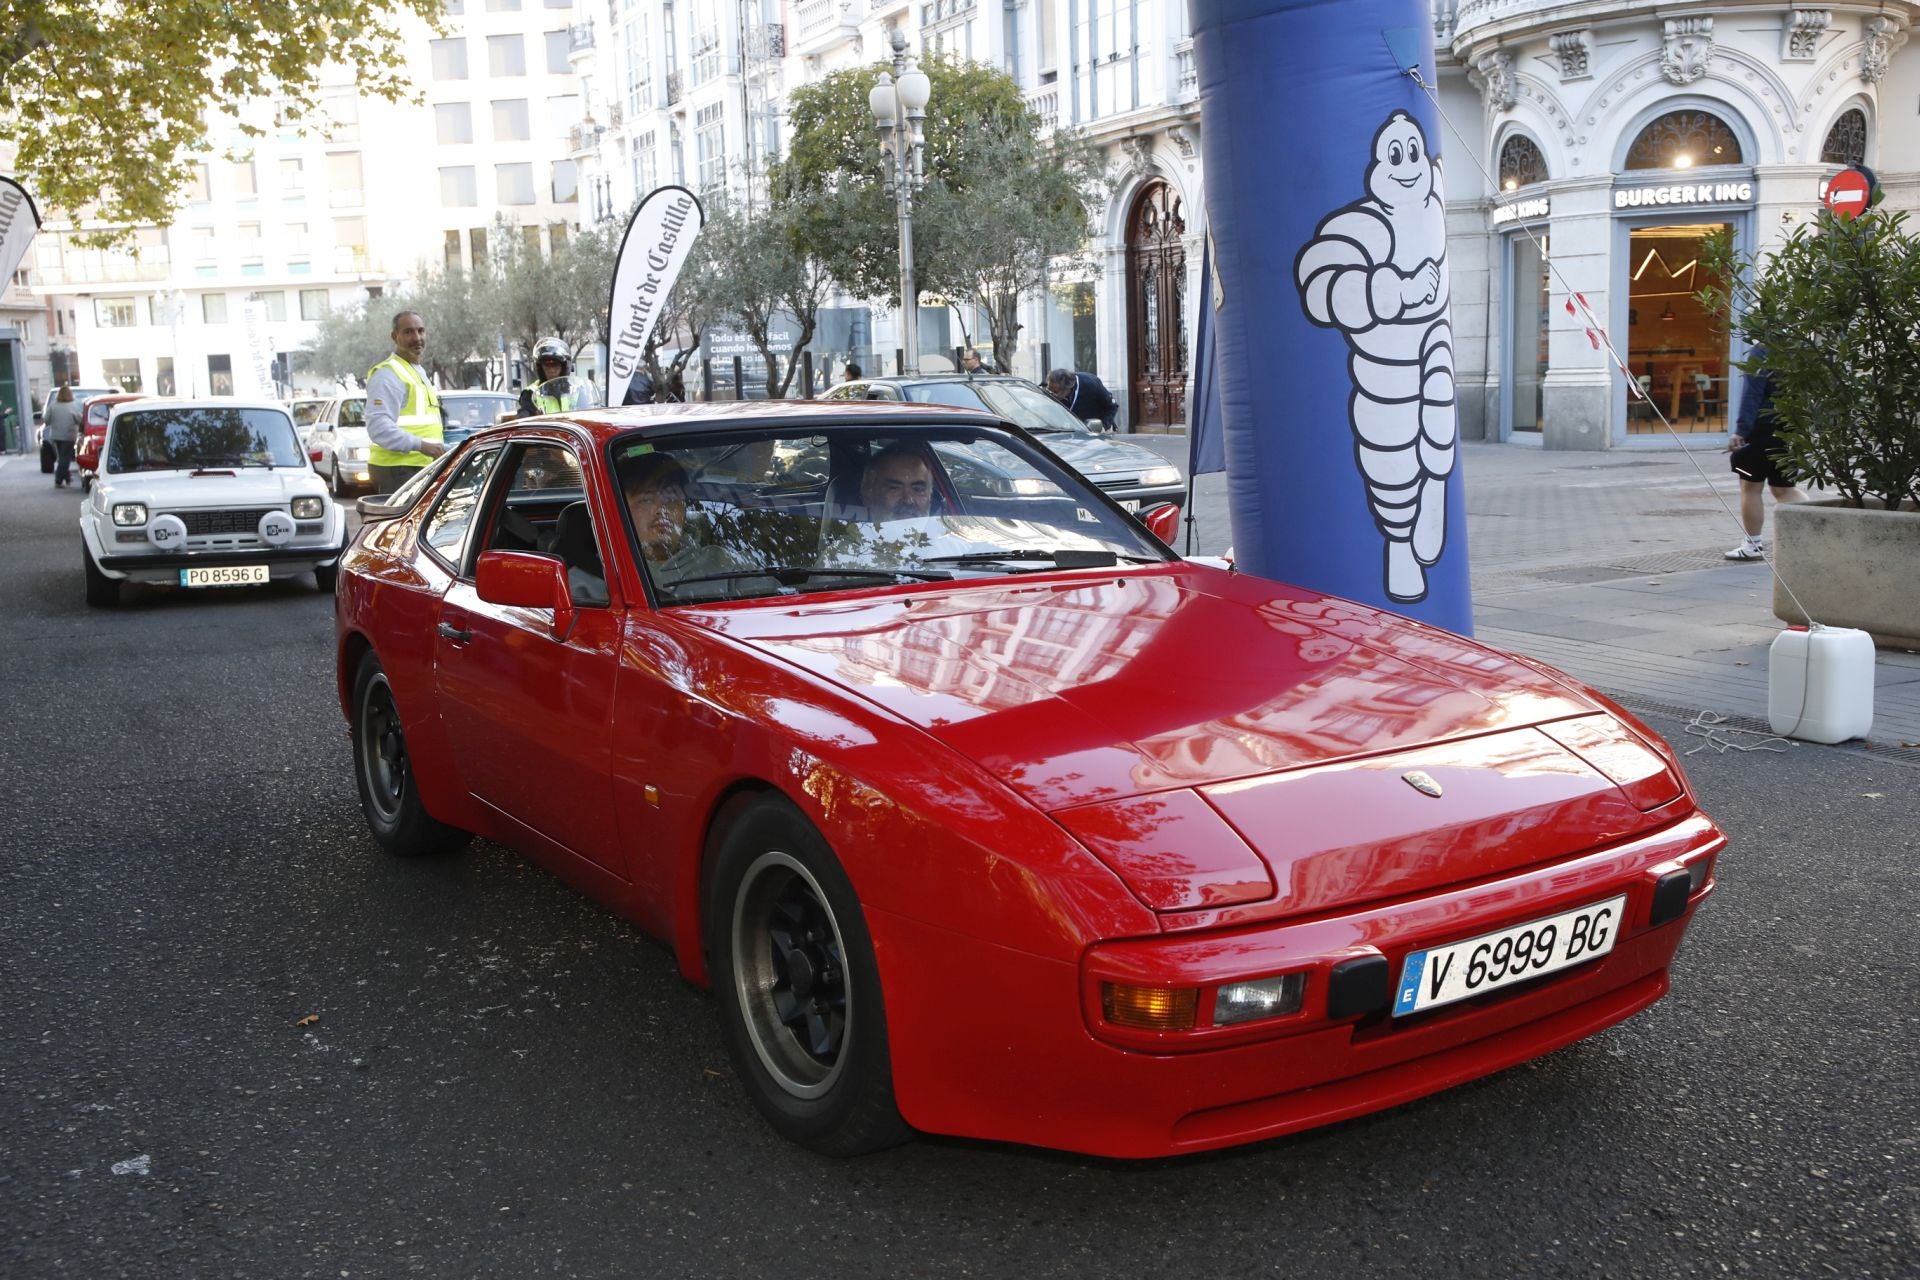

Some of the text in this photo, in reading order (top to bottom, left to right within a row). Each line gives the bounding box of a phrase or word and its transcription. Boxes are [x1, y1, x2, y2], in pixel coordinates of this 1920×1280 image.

[1615, 183, 1752, 208] BURGER KING
[1517, 198, 1549, 218] KING
[612, 197, 693, 380] El Norte de Castilla
[710, 343, 745, 354] cuando
[190, 568, 263, 584] PO 8596 G
[1430, 908, 1612, 1001] V 6999 BG
[1402, 988, 1415, 1003] E
